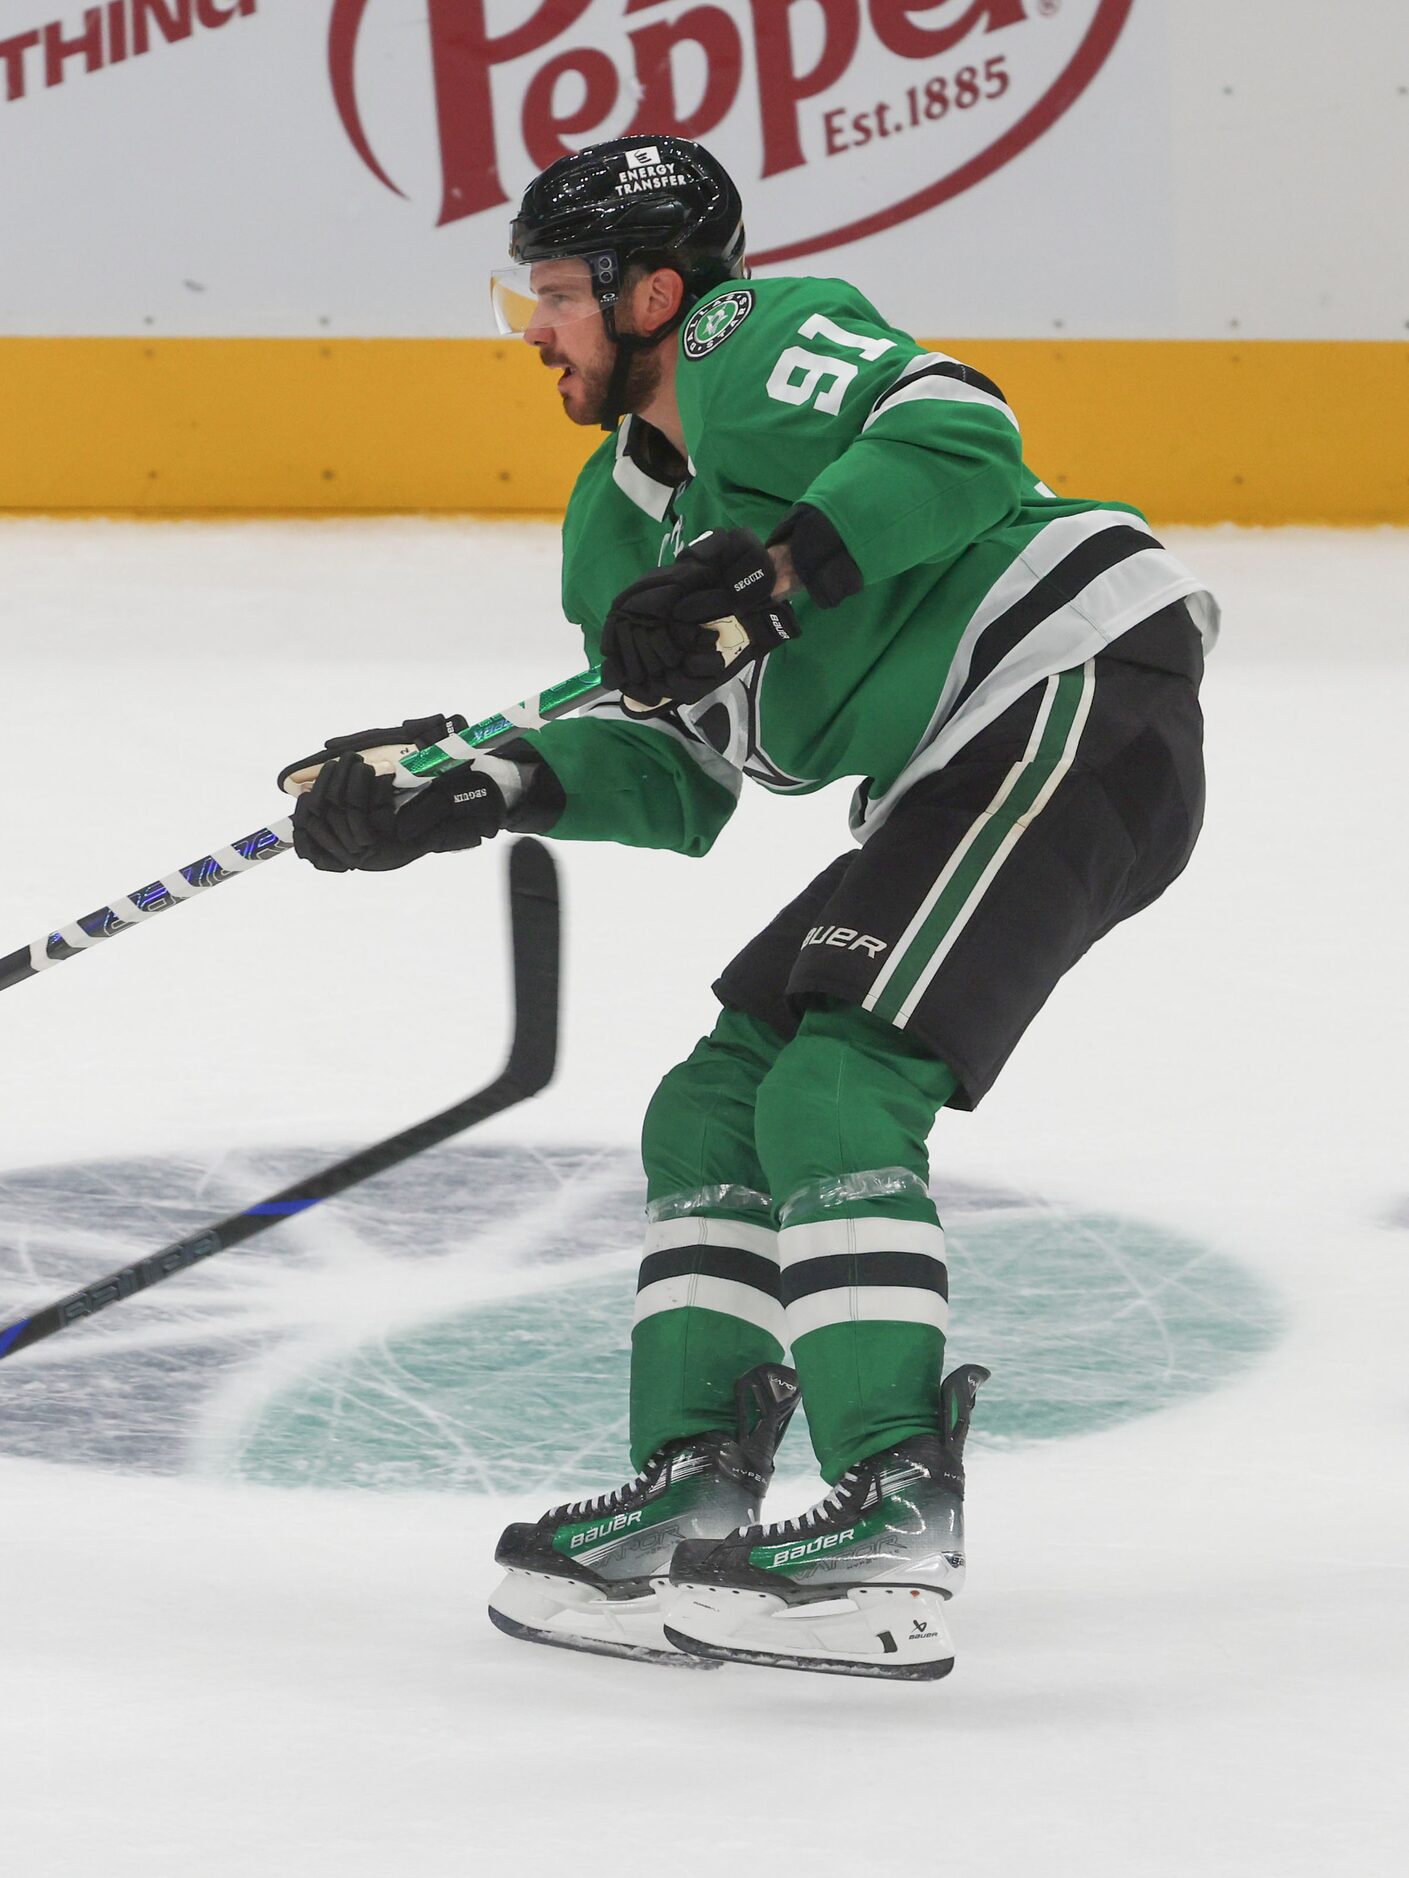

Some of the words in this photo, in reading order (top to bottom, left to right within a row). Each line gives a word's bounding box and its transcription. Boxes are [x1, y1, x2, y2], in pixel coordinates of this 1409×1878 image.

[435, 0, 1028, 228] Pepp
[618, 163, 675, 183] ENERGY
[614, 175, 688, 196] TRANSFER
[765, 312, 898, 416] 91
[734, 568, 765, 592] SEGUIN
